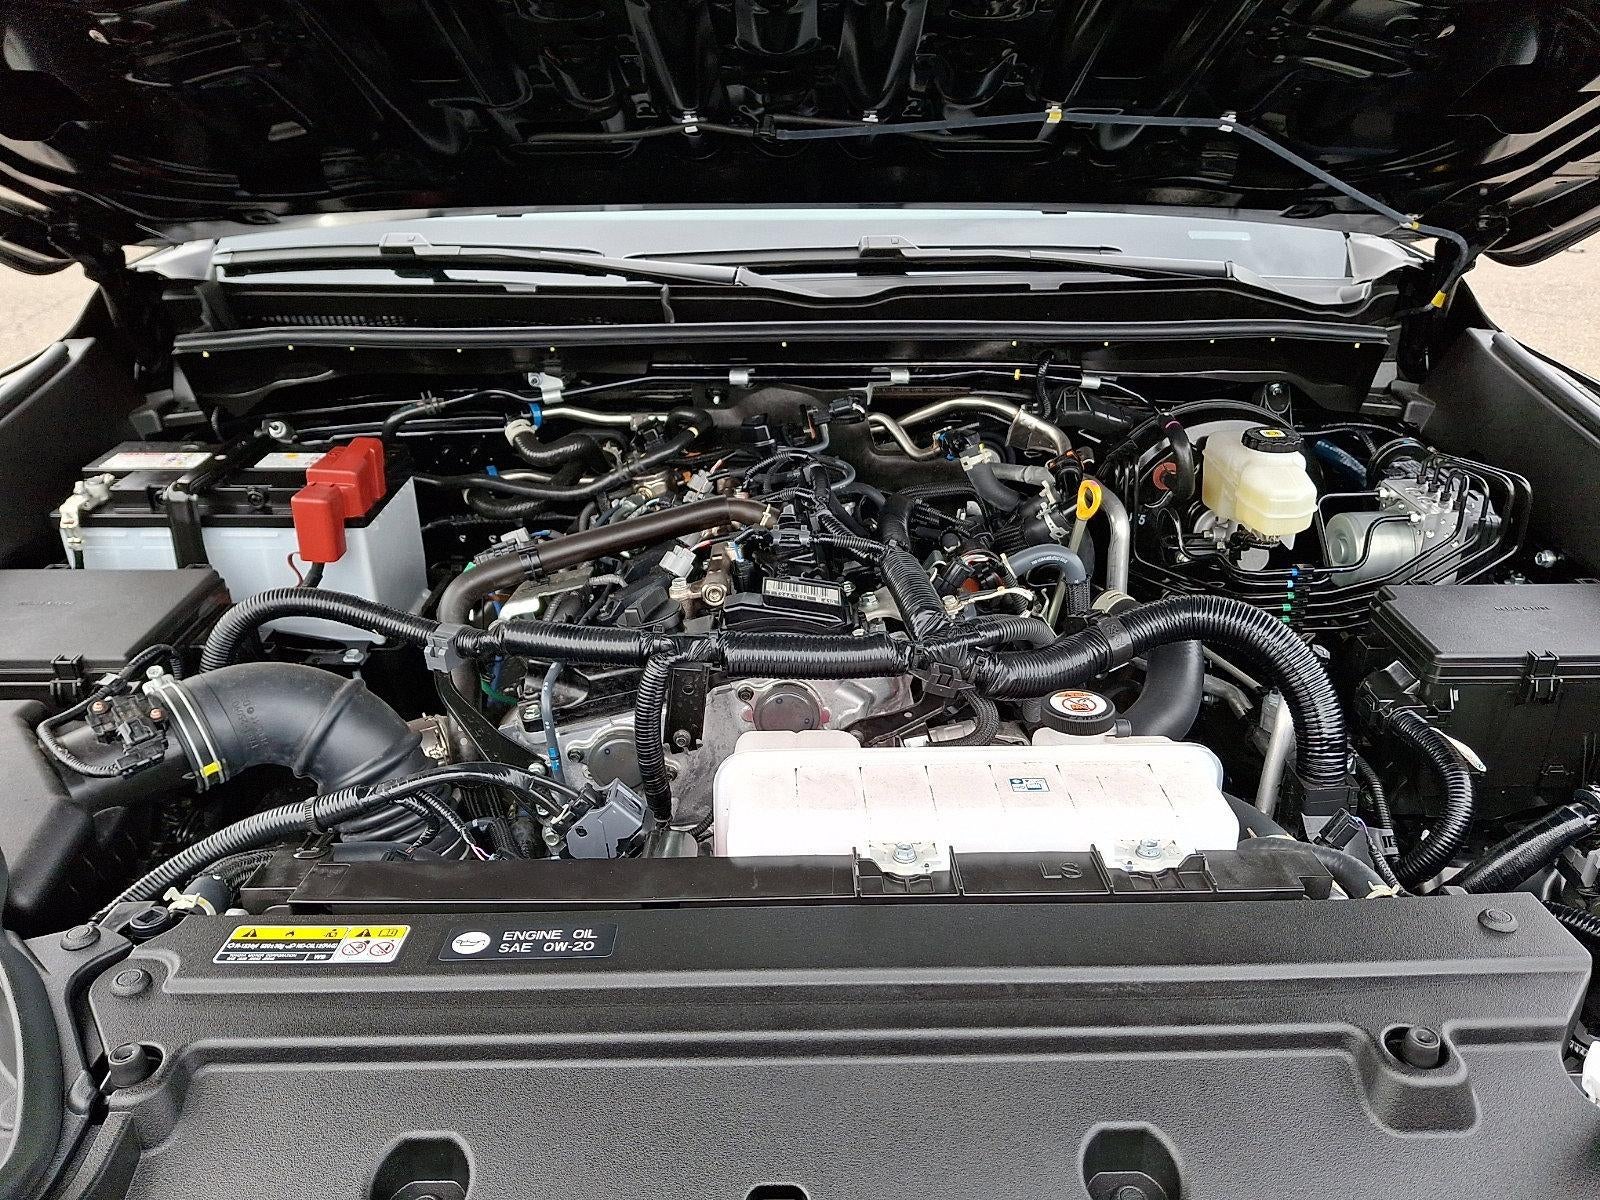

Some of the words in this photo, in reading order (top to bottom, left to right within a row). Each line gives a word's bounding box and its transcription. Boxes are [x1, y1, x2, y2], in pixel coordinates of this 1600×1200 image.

[1038, 862, 1083, 879] LS
[502, 929, 564, 941] ENGINE
[572, 928, 598, 939] OIL
[498, 942, 534, 953] SAE
